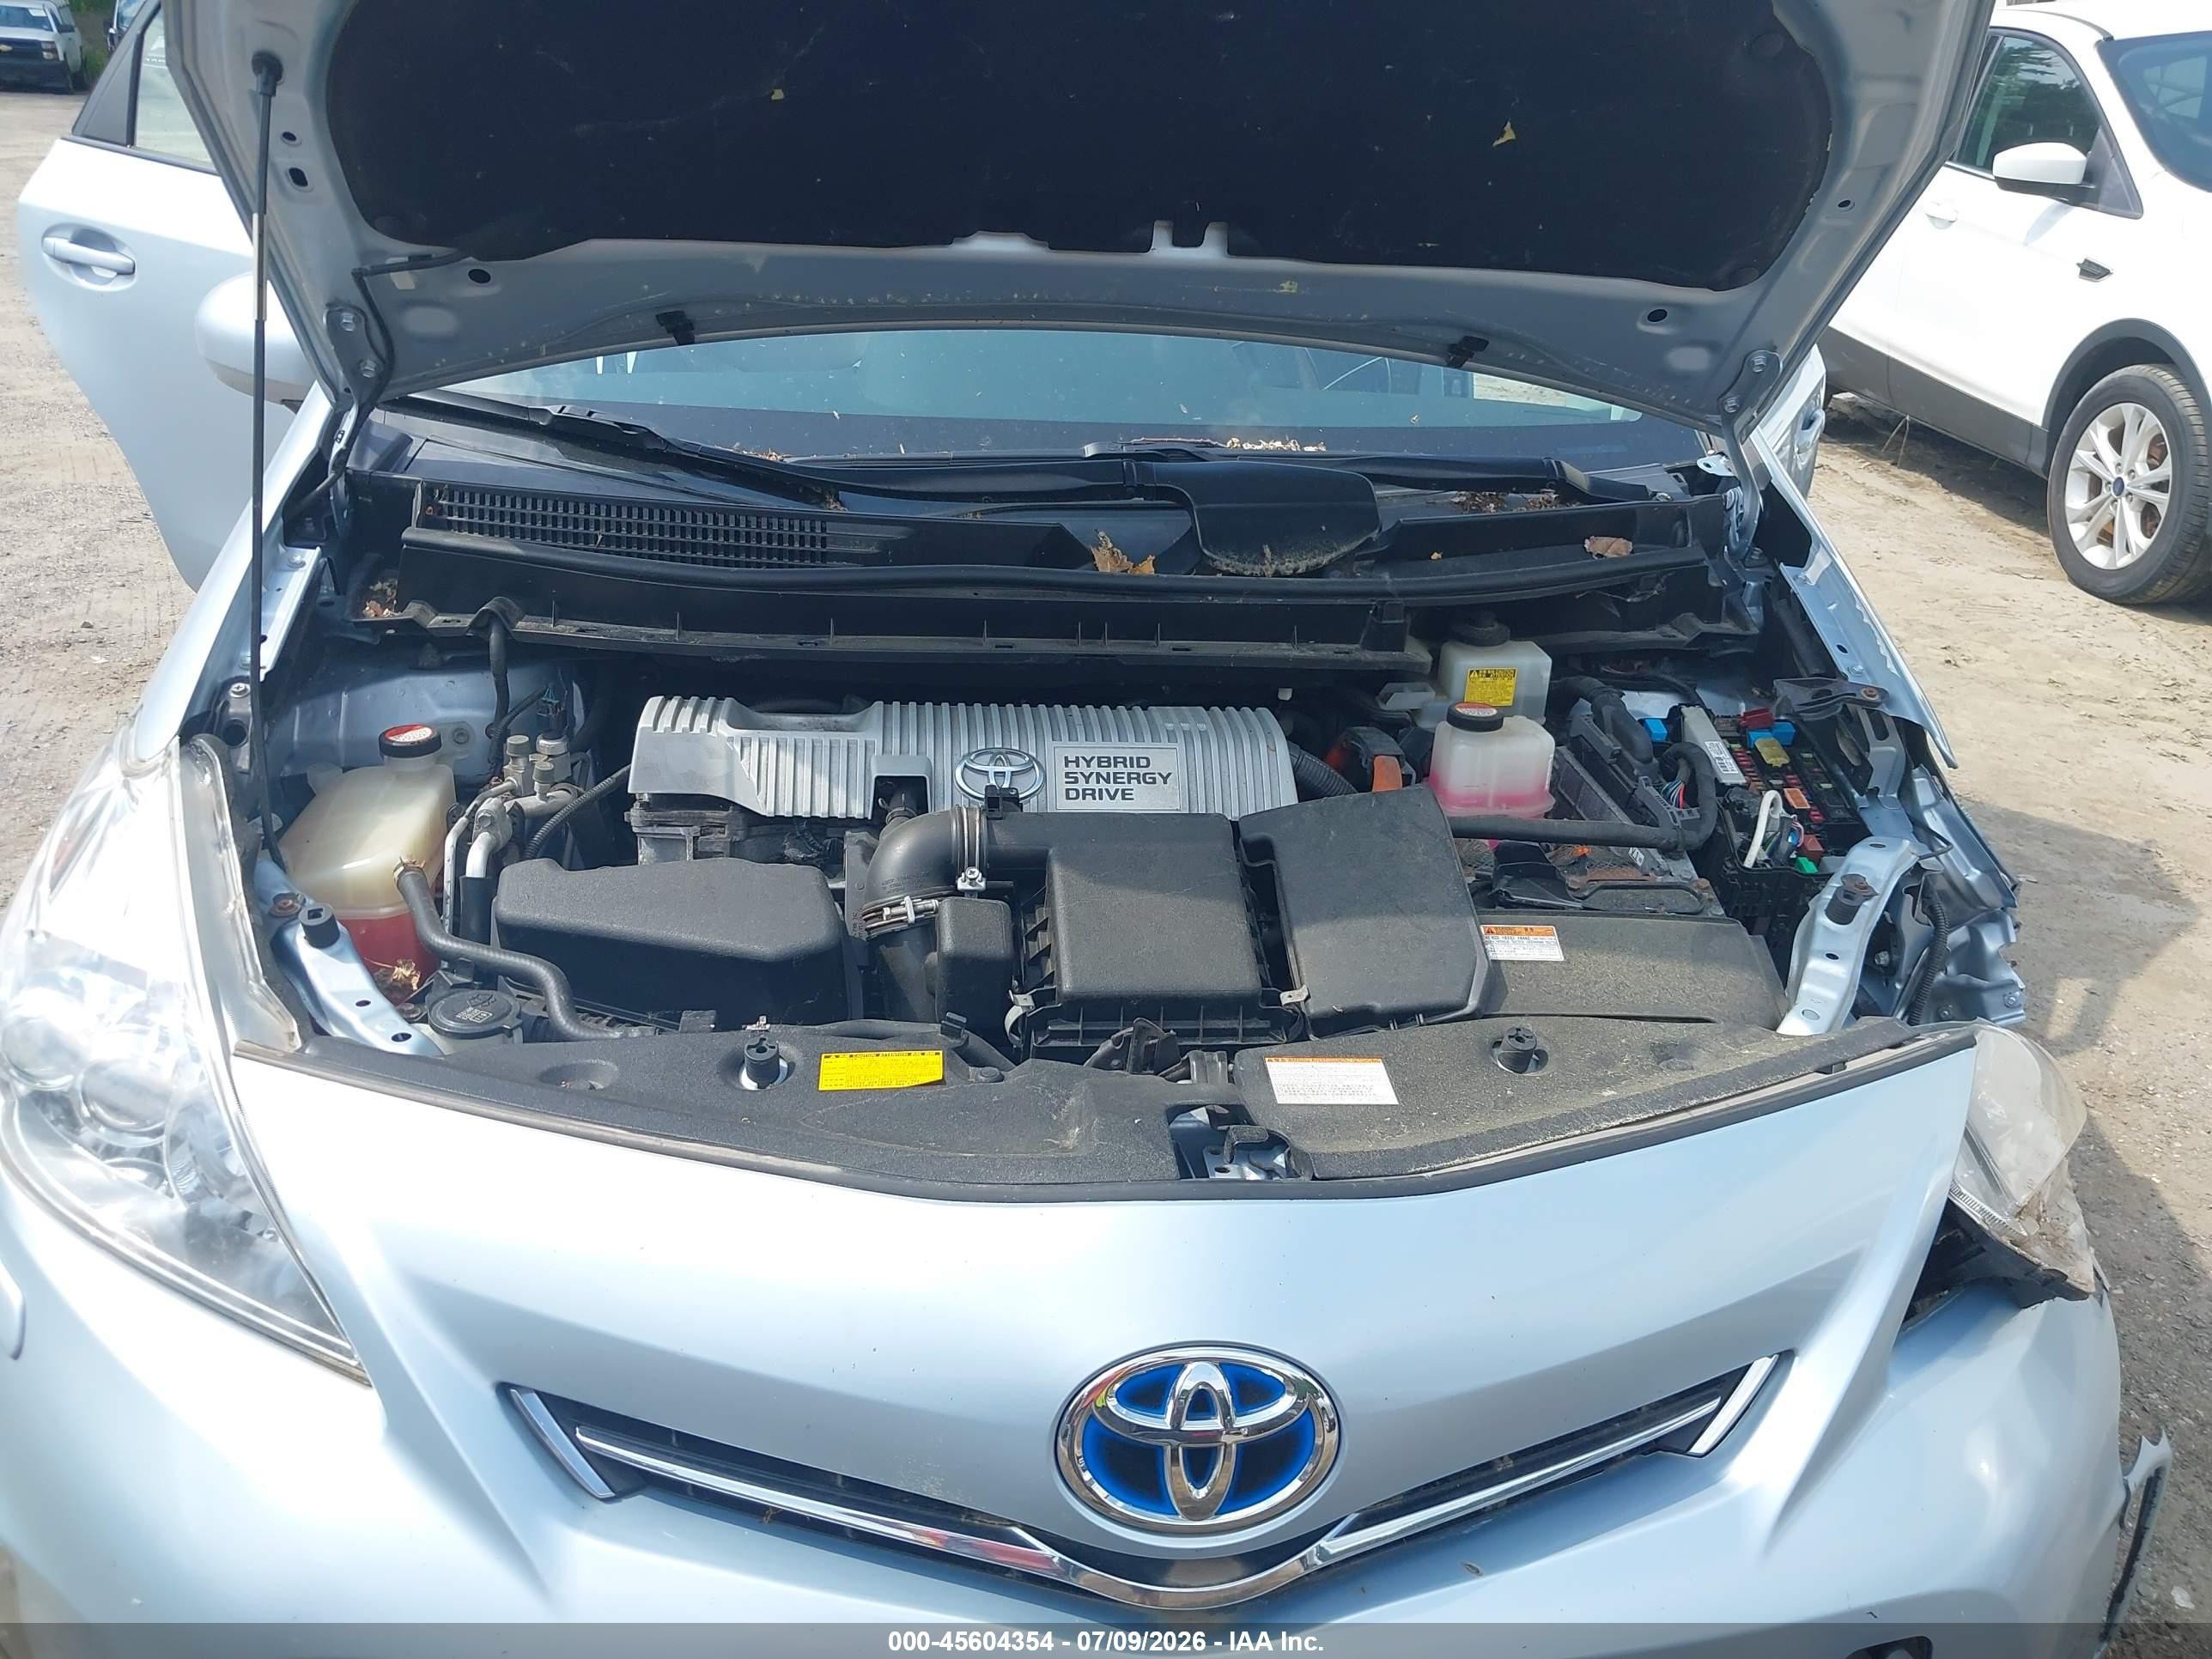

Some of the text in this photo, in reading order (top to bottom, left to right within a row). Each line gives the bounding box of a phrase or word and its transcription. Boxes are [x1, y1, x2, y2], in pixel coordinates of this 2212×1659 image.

[1064, 756, 1151, 769] HYBRID
[1064, 772, 1172, 785] SYNERGY
[1065, 787, 1134, 800] DRIVE
